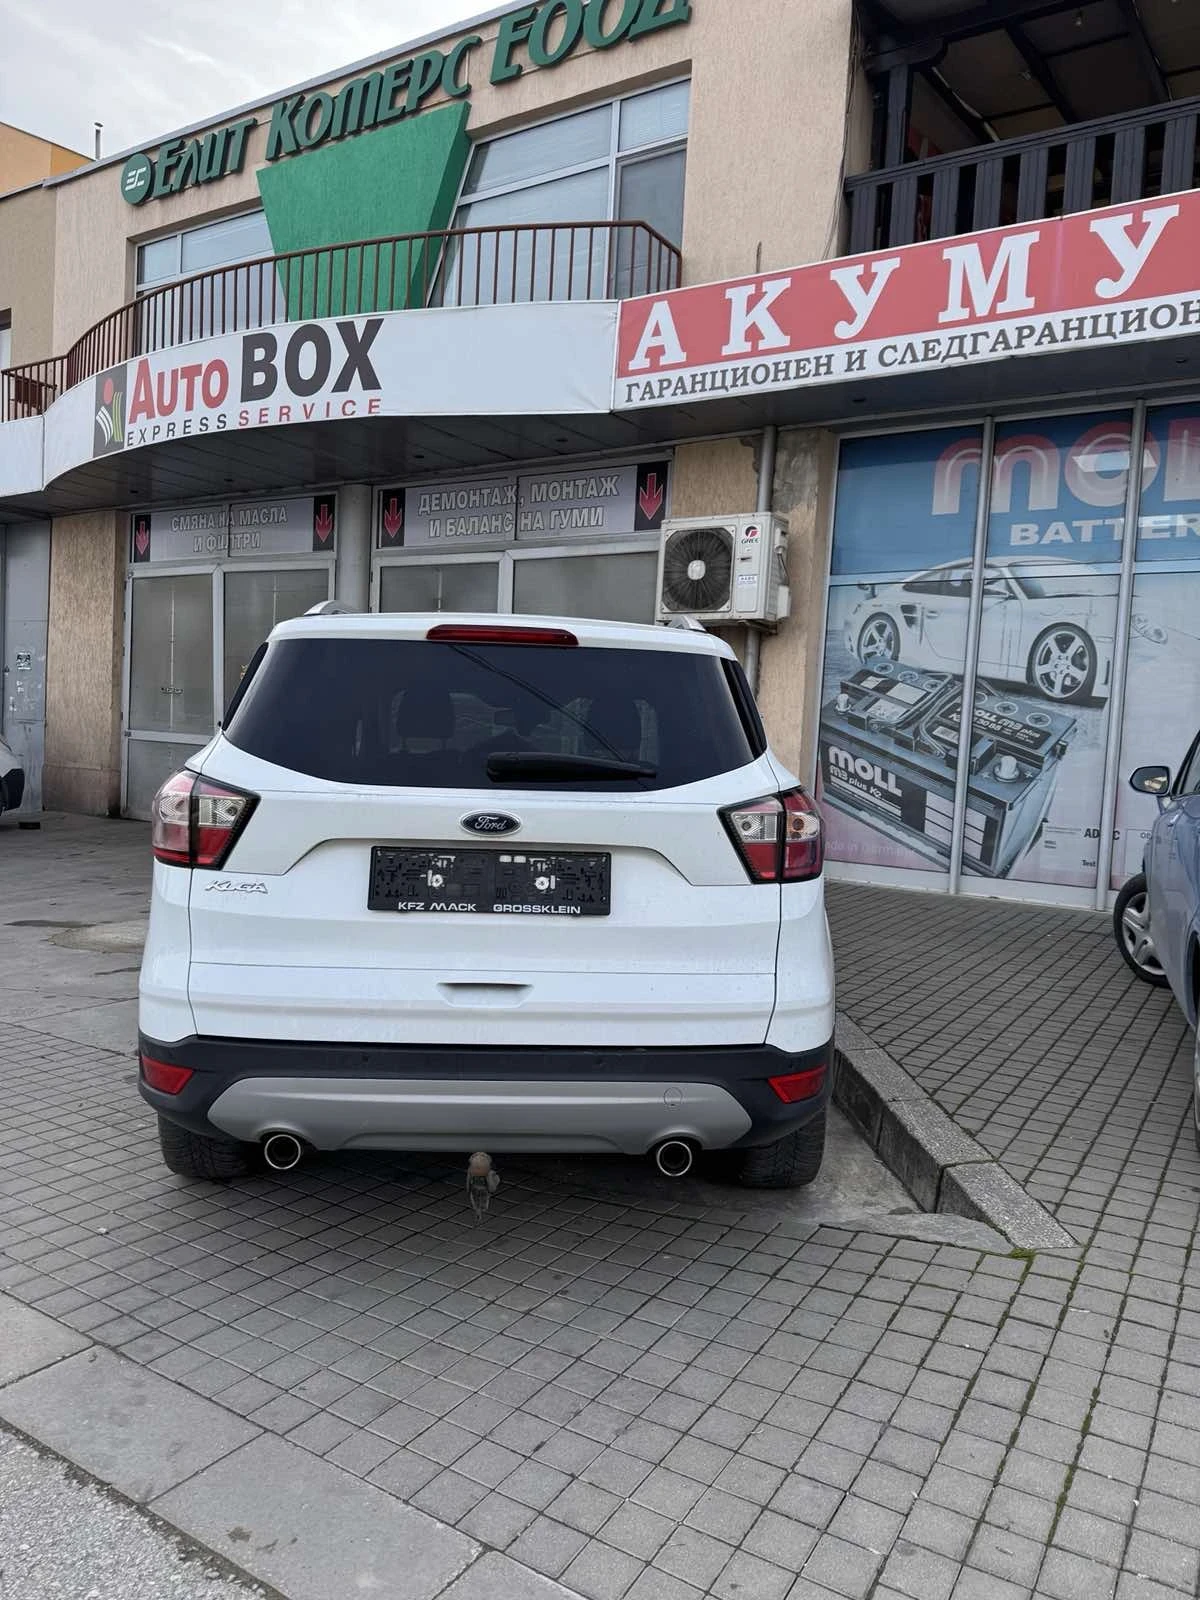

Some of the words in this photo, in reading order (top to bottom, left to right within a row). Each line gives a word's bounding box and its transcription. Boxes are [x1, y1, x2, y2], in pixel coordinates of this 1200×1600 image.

[240, 317, 385, 403] BOX
[625, 353, 833, 403] ГАРАНЦИОНЕН
[844, 349, 867, 373] И
[126, 413, 228, 447] EXPRESS
[238, 398, 382, 428] SERVICE
[530, 475, 620, 504] МОНТАЖ
[171, 512, 216, 532] СМЯНА
[239, 504, 288, 527] МАСЛА
[429, 519, 440, 538] И
[445, 512, 514, 537] БАЛАНС
[519, 510, 545, 532] НА
[550, 506, 605, 530] ГУМИ
[193, 536, 203, 552] И
[849, 777, 868, 791] plus
[474, 815, 508, 831] Ford
[1083, 827, 1121, 841] ADC
[1082, 859, 1097, 868] Test
[398, 901, 425, 911] KFZ
[429, 902, 477, 912] MACK
[492, 903, 581, 914] GROSSKLEIN
